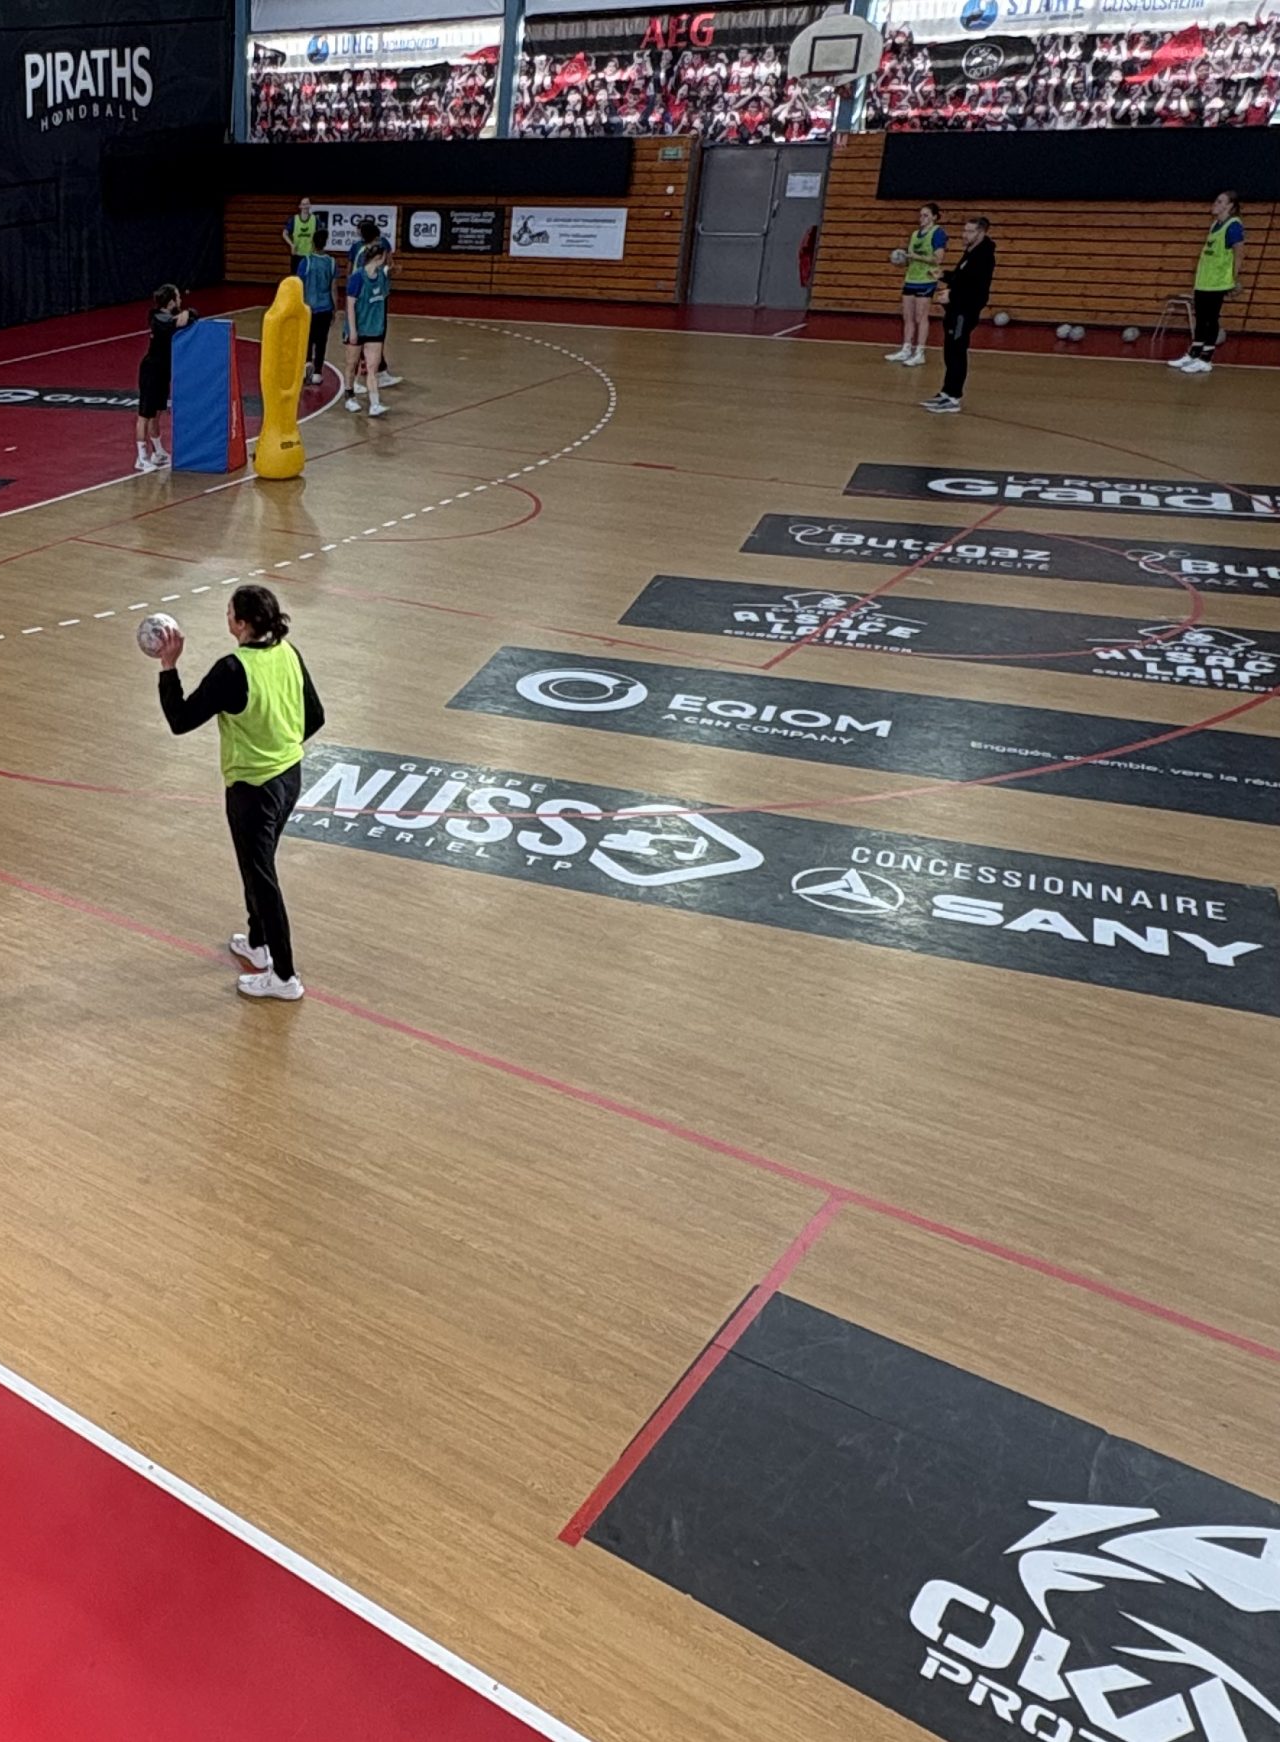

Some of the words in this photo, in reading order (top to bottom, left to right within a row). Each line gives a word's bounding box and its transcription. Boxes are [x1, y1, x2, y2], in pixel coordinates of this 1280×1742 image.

[640, 12, 716, 49] AEG
[24, 46, 153, 120] PIRATHS
[413, 223, 438, 238] gan
[927, 477, 1234, 512] Grand
[1007, 475, 1040, 486] La
[1063, 478, 1199, 494] Région
[824, 546, 874, 557] GAZ
[829, 531, 1053, 562] Butagaz
[733, 610, 921, 640] ALSACE
[770, 622, 869, 642] LAIT
[1145, 661, 1261, 684] LAIT
[661, 713, 679, 722] A
[683, 715, 732, 729] CRH
[735, 722, 854, 746] COMPANY
[668, 693, 893, 738] EQIOM
[399, 762, 548, 795] GROUPE
[1170, 767, 1214, 780] vers
[1220, 774, 1238, 784] la
[294, 762, 604, 857] NUSS
[525, 854, 573, 872] TP
[850, 846, 1228, 923] CONCESSIONNAIRE
[930, 893, 1264, 968] SANY
